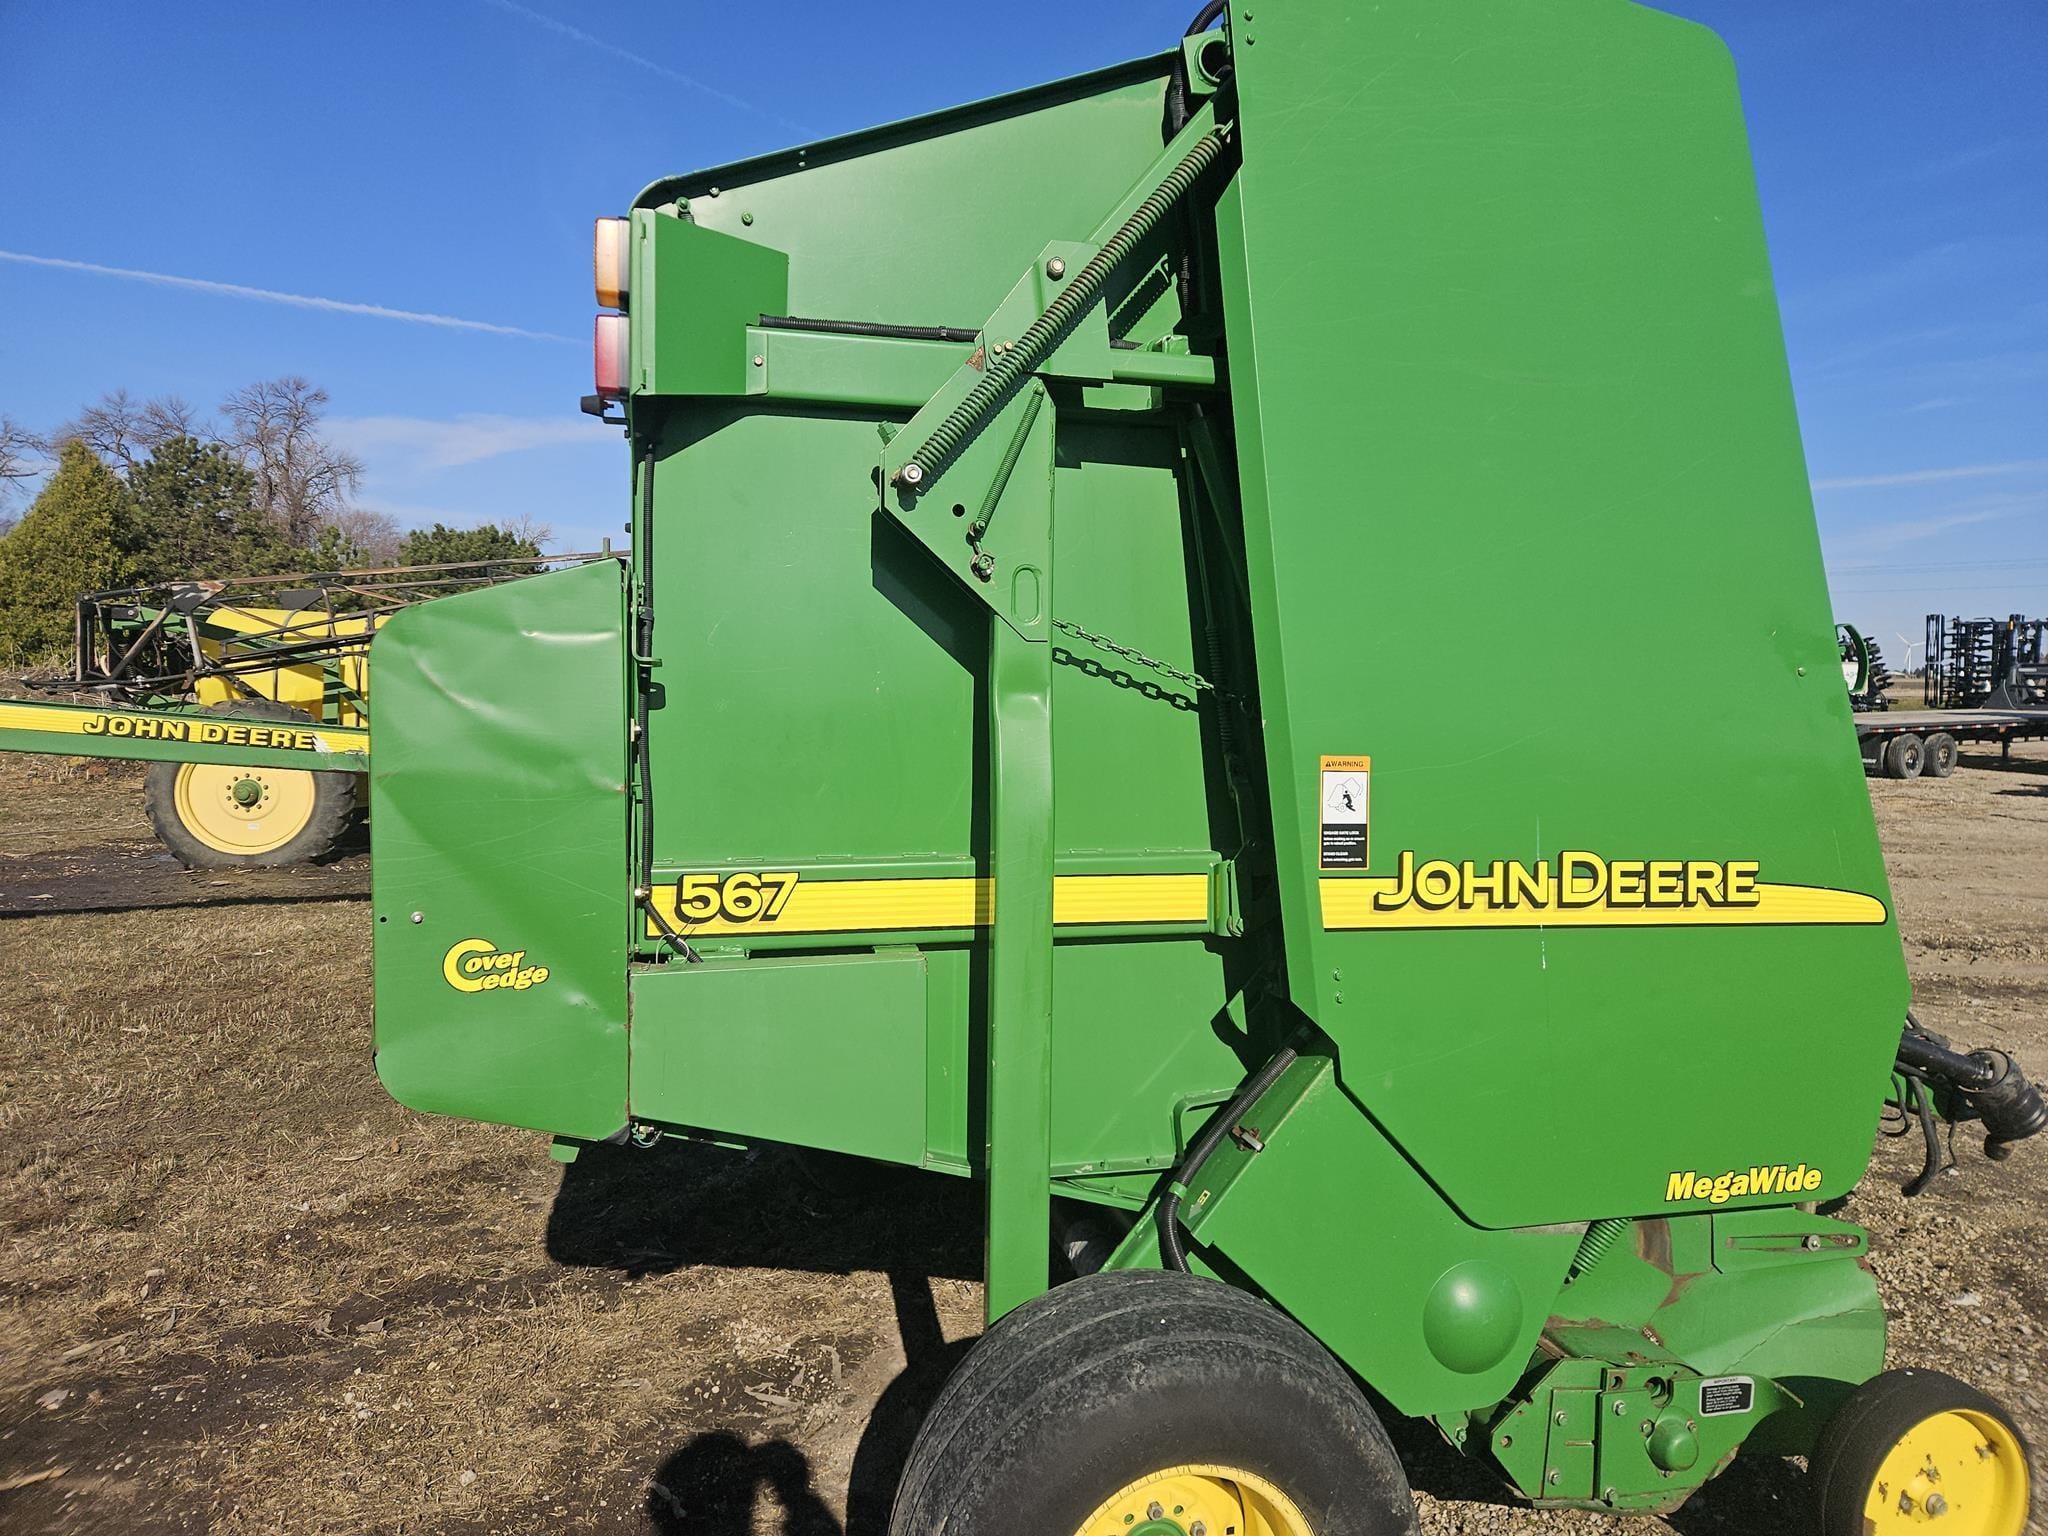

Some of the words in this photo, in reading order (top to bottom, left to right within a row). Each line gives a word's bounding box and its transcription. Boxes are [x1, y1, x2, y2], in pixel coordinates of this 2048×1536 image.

[83, 715, 190, 740] JOHN
[201, 723, 316, 750] DEERE
[1331, 760, 1364, 768] WARNING
[674, 872, 800, 924] 567
[1373, 849, 1550, 911] JOHN
[1557, 850, 1760, 910] DEERE
[442, 937, 527, 993] Cover
[482, 966, 550, 990] edge
[1665, 1163, 1823, 1205] MegaWide
